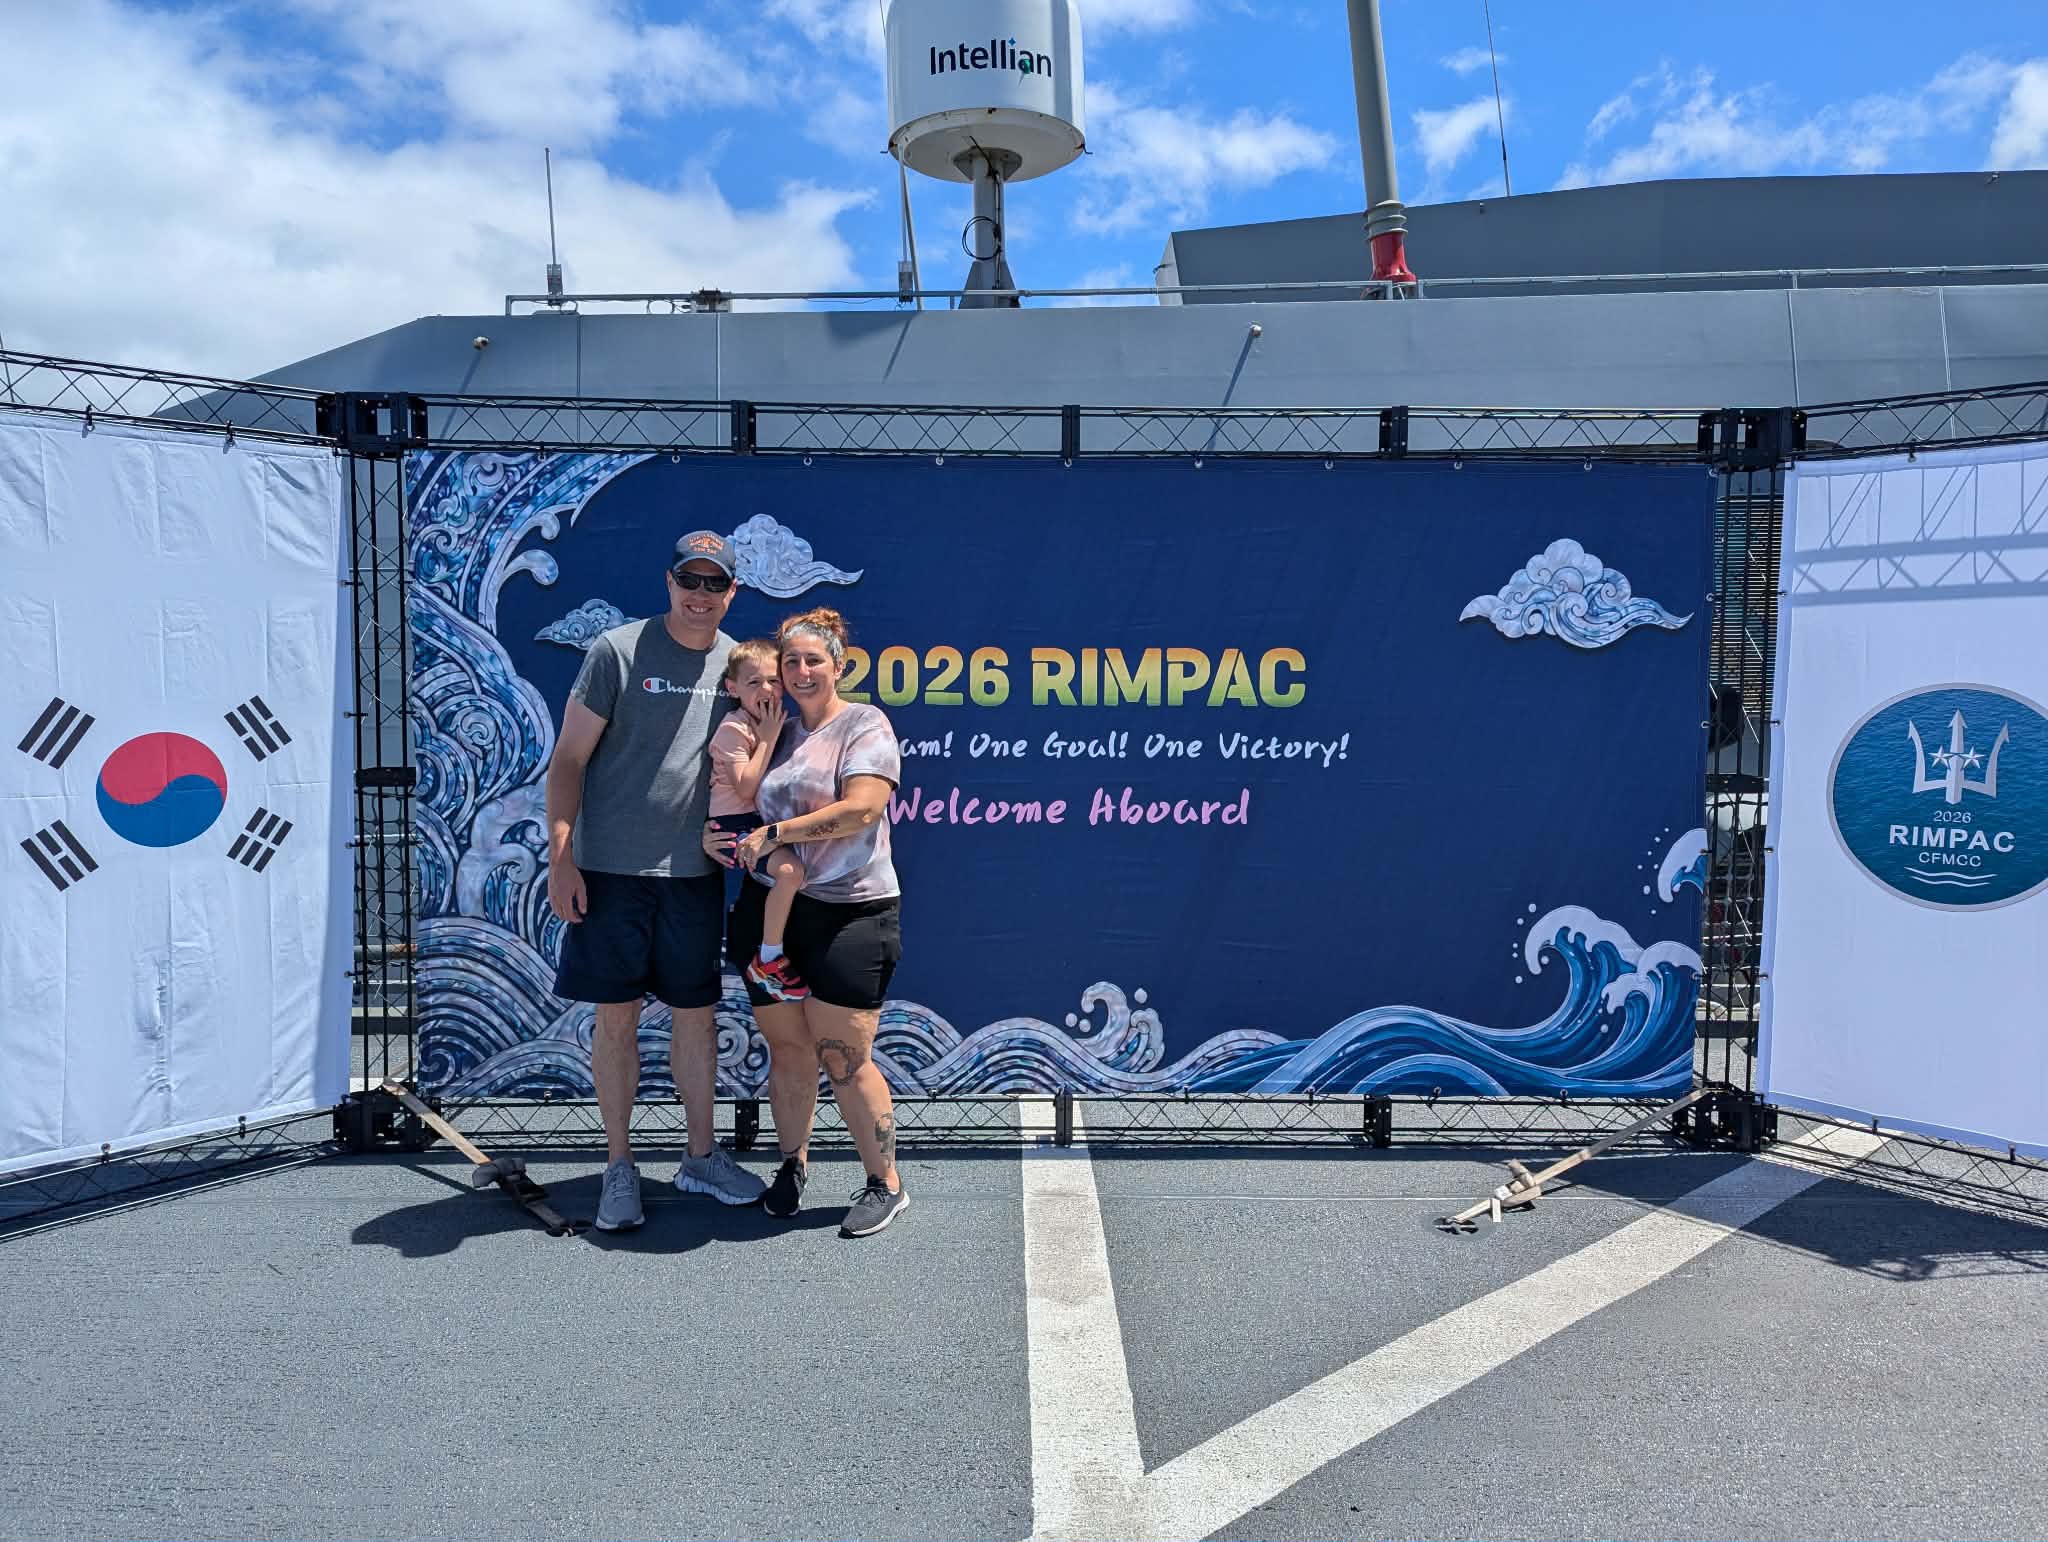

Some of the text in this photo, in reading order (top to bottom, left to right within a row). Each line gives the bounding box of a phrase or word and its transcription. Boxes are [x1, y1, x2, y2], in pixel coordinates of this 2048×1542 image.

[930, 38, 1052, 77] Intellian
[838, 645, 1306, 708] 2026 RIMPAC
[899, 731, 1350, 768] am! One Goal! One Victory!
[890, 787, 1250, 825] Welcome Aboard
[1934, 810, 1972, 824] 2026
[1889, 825, 2015, 852] RIMPAC
[1919, 852, 1982, 867] CFMCC
